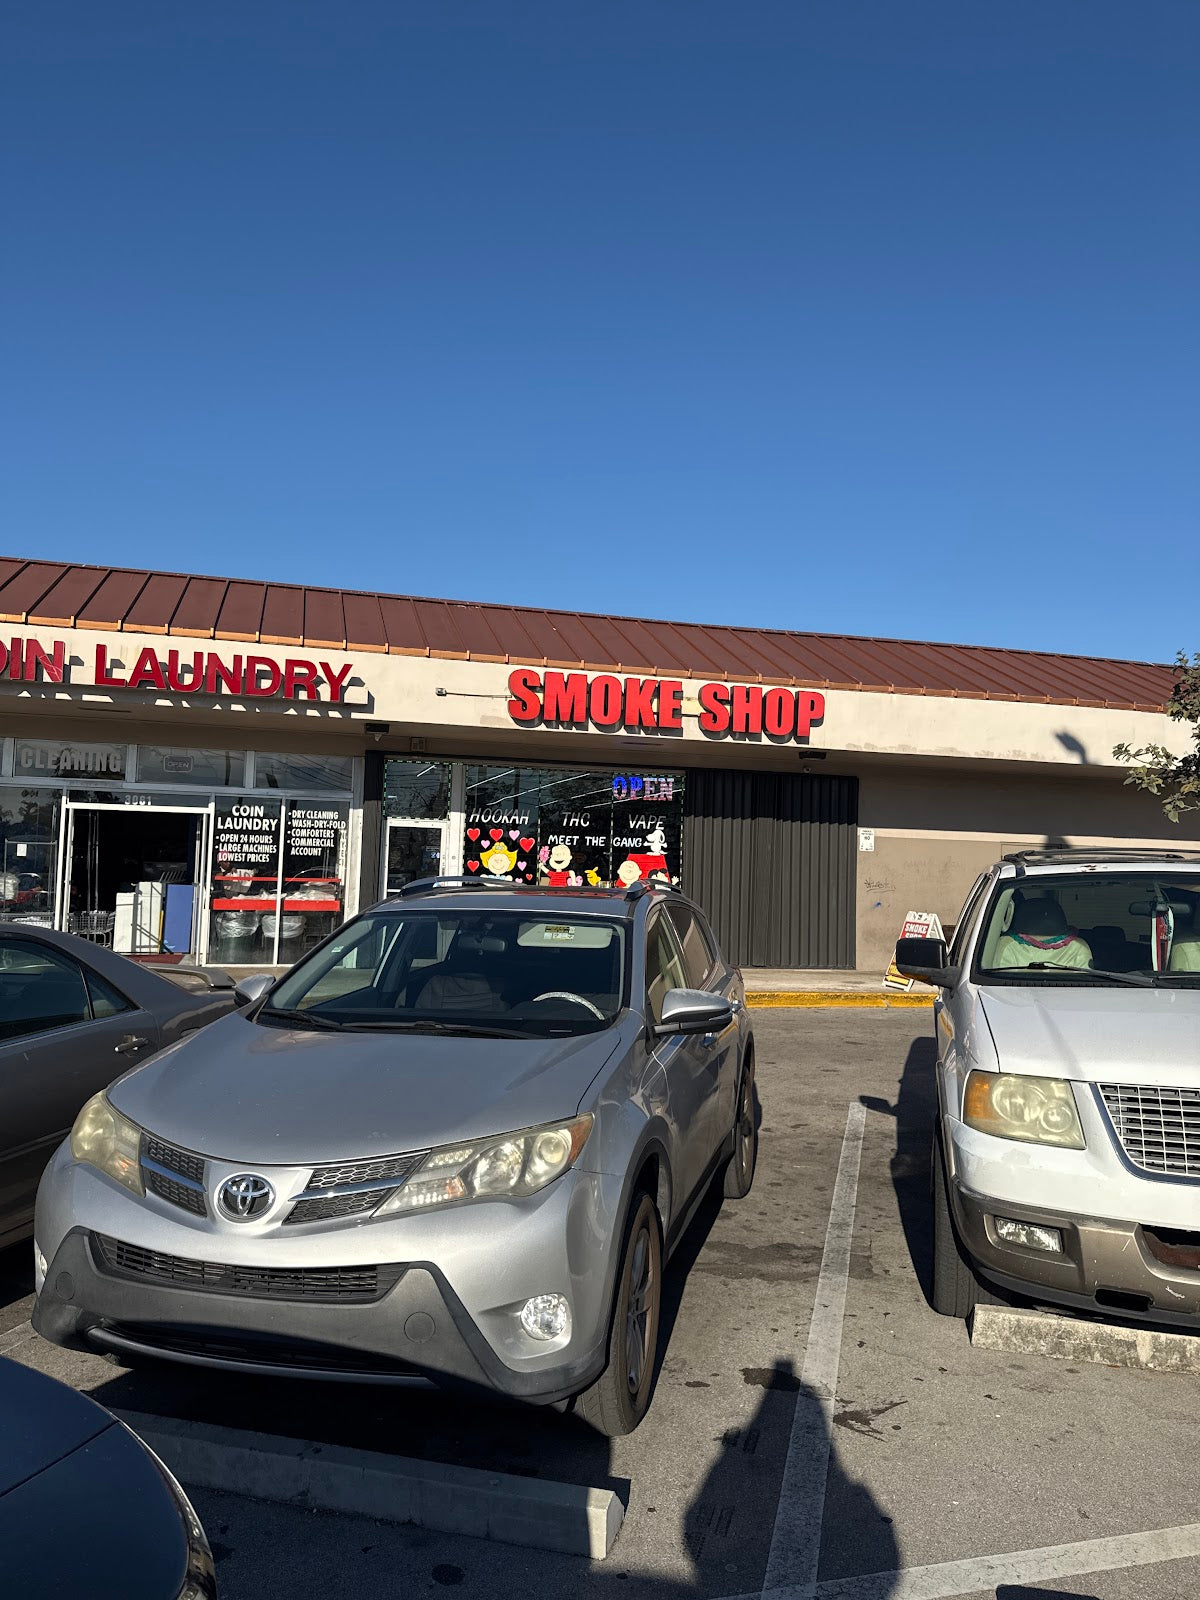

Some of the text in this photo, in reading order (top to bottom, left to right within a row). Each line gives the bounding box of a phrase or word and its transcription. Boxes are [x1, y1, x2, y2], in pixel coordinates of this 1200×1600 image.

[0, 637, 354, 703] IN LAUNDRY
[508, 669, 826, 738] SMOKE SHOP
[20, 748, 122, 772] CLEANING
[167, 760, 190, 769] OPEN
[612, 775, 675, 801] OPEN
[231, 805, 264, 818] COIN
[291, 810, 339, 819] DRY CLEANING
[469, 807, 531, 825] HOOKAH
[217, 816, 278, 831] LAUNDRY
[291, 819, 346, 829] WASH-DRY-FOLD
[562, 811, 591, 828] THC
[628, 813, 667, 831] VAPE
[220, 833, 273, 844] OPEN 24 HOURS
[291, 828, 335, 838] COMFORTERS
[291, 838, 335, 847] COMMERCIAL
[547, 834, 643, 848] MEET THE GANG
[219, 843, 277, 854] LARGE MACHINES
[290, 847, 322, 856] ACCOUNT
[218, 852, 270, 863] LOWEST PRICES
[904, 922, 929, 934] SMOKE
